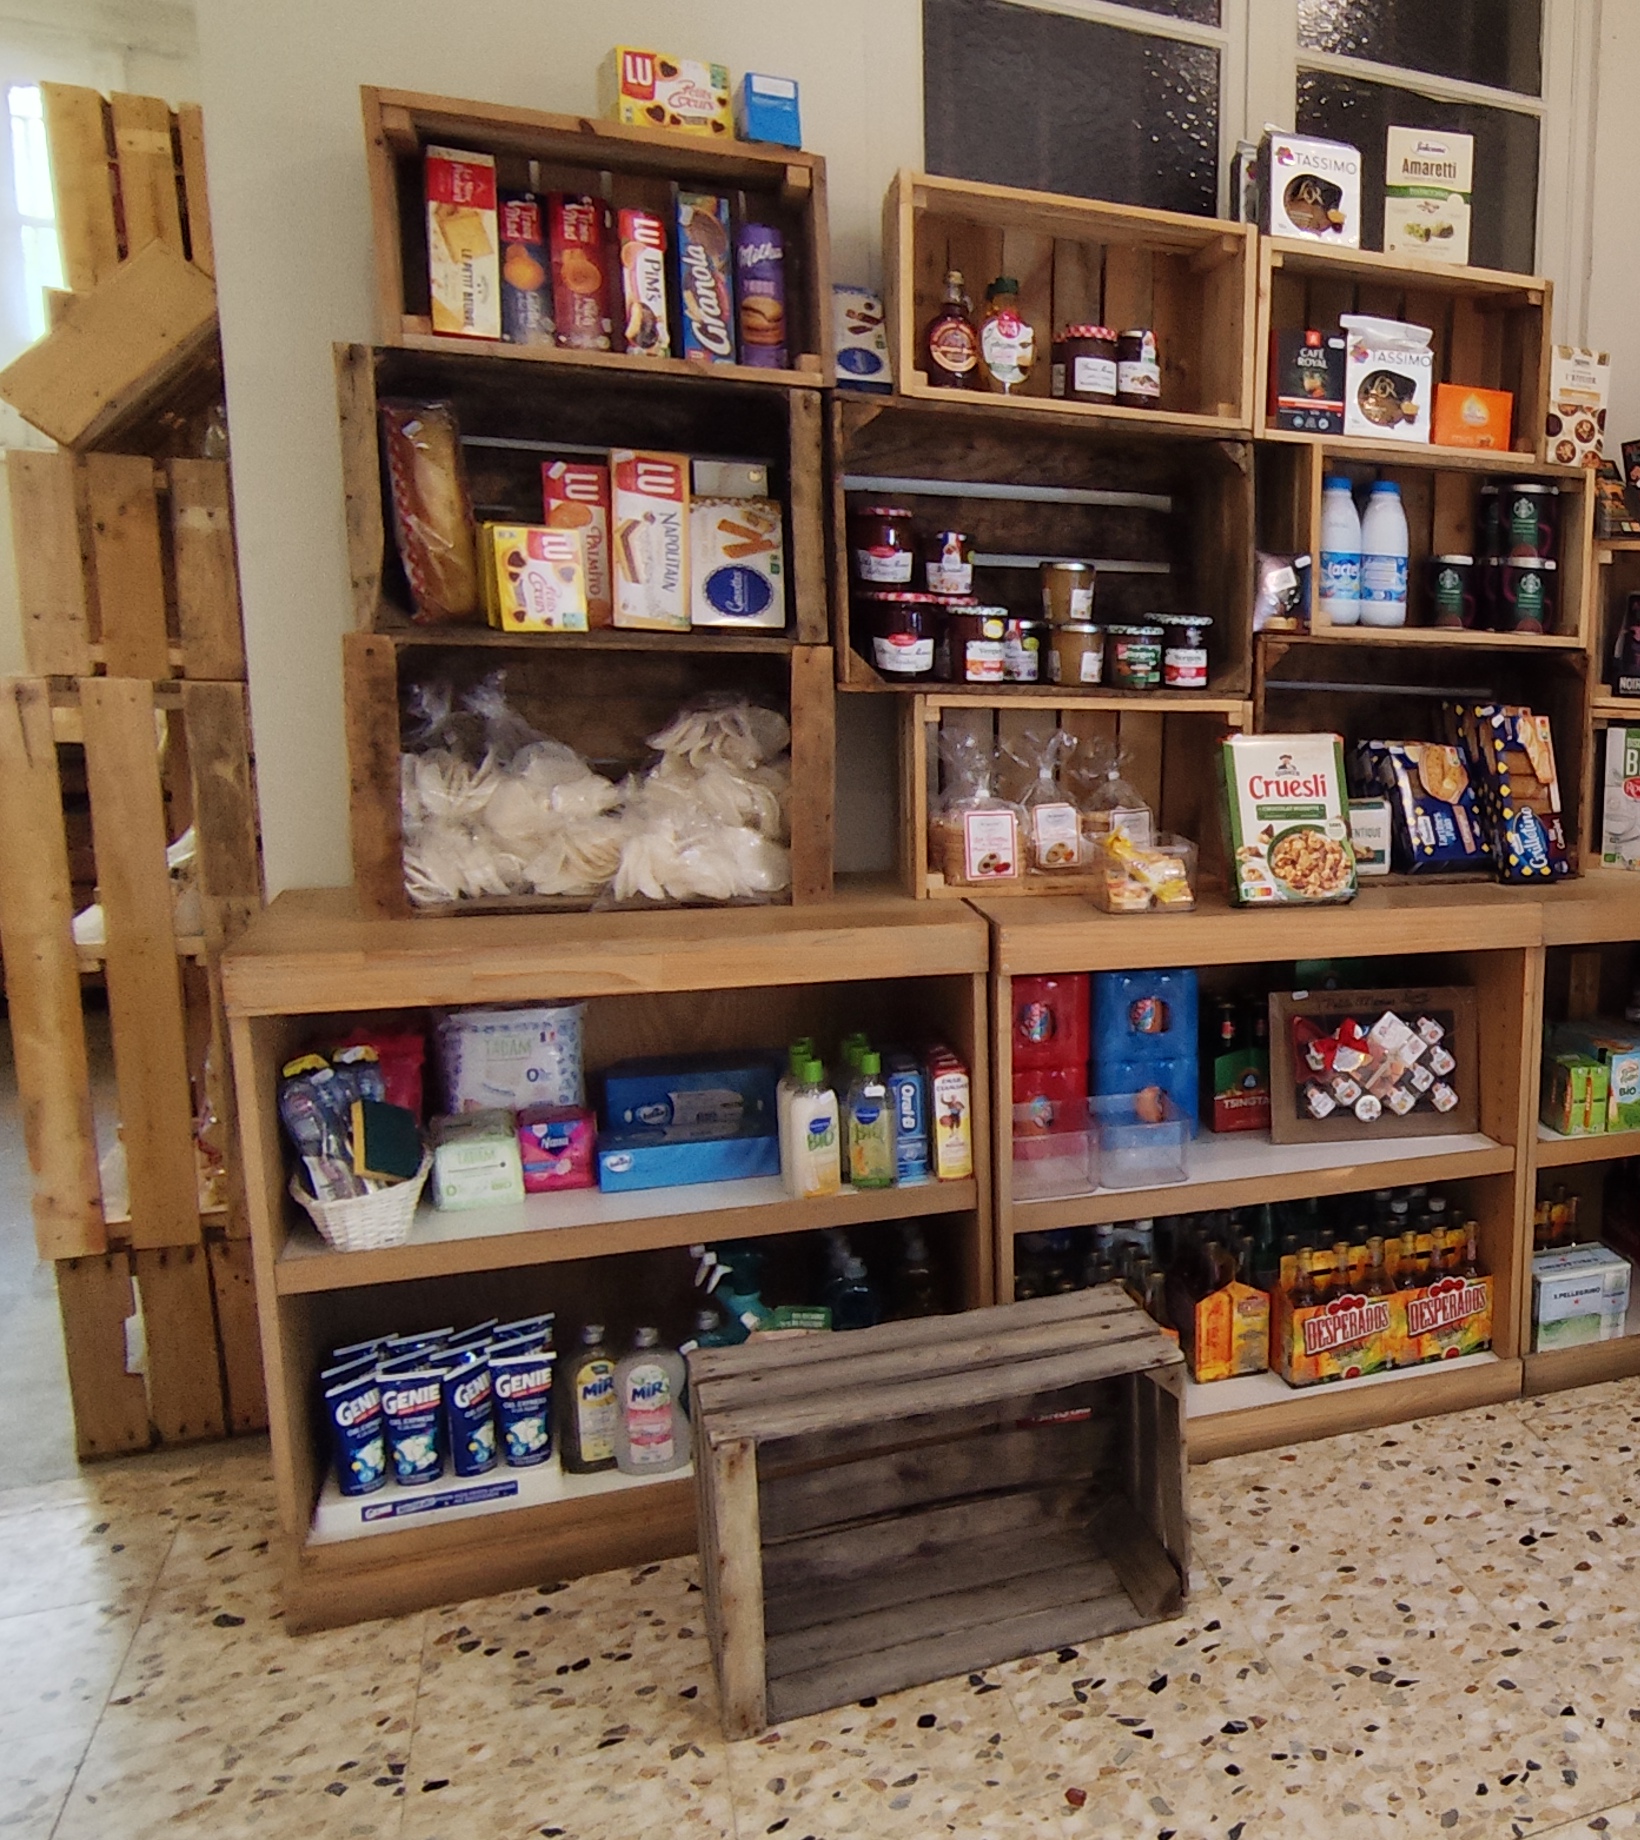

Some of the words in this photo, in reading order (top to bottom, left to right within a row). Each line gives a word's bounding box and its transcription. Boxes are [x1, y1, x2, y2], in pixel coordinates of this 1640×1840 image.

[625, 53, 653, 86] LU
[1295, 151, 1357, 176] TASSIMO
[1401, 158, 1457, 179] Amaretti
[633, 217, 660, 249] LU
[738, 242, 784, 268] Milka
[462, 262, 474, 290] PETIT
[681, 245, 731, 356] Granola
[1297, 357, 1328, 369] ROYAL
[1371, 350, 1432, 368] TASSIMO
[564, 472, 600, 501] LU
[636, 462, 676, 495] LU
[541, 535, 574, 561] LU
[659, 511, 682, 593] NAPOLITAIN
[1249, 774, 1328, 800] Cruesli
[1222, 1095, 1270, 1110] TSINGTA
[1409, 1286, 1487, 1334] DESPERADOS
[1306, 1303, 1389, 1352] DESPERADOS
[382, 1382, 441, 1415] GENIE
[454, 1369, 491, 1409] GENI
[495, 1367, 552, 1399] GENIE
[335, 1387, 381, 1427] GENI
